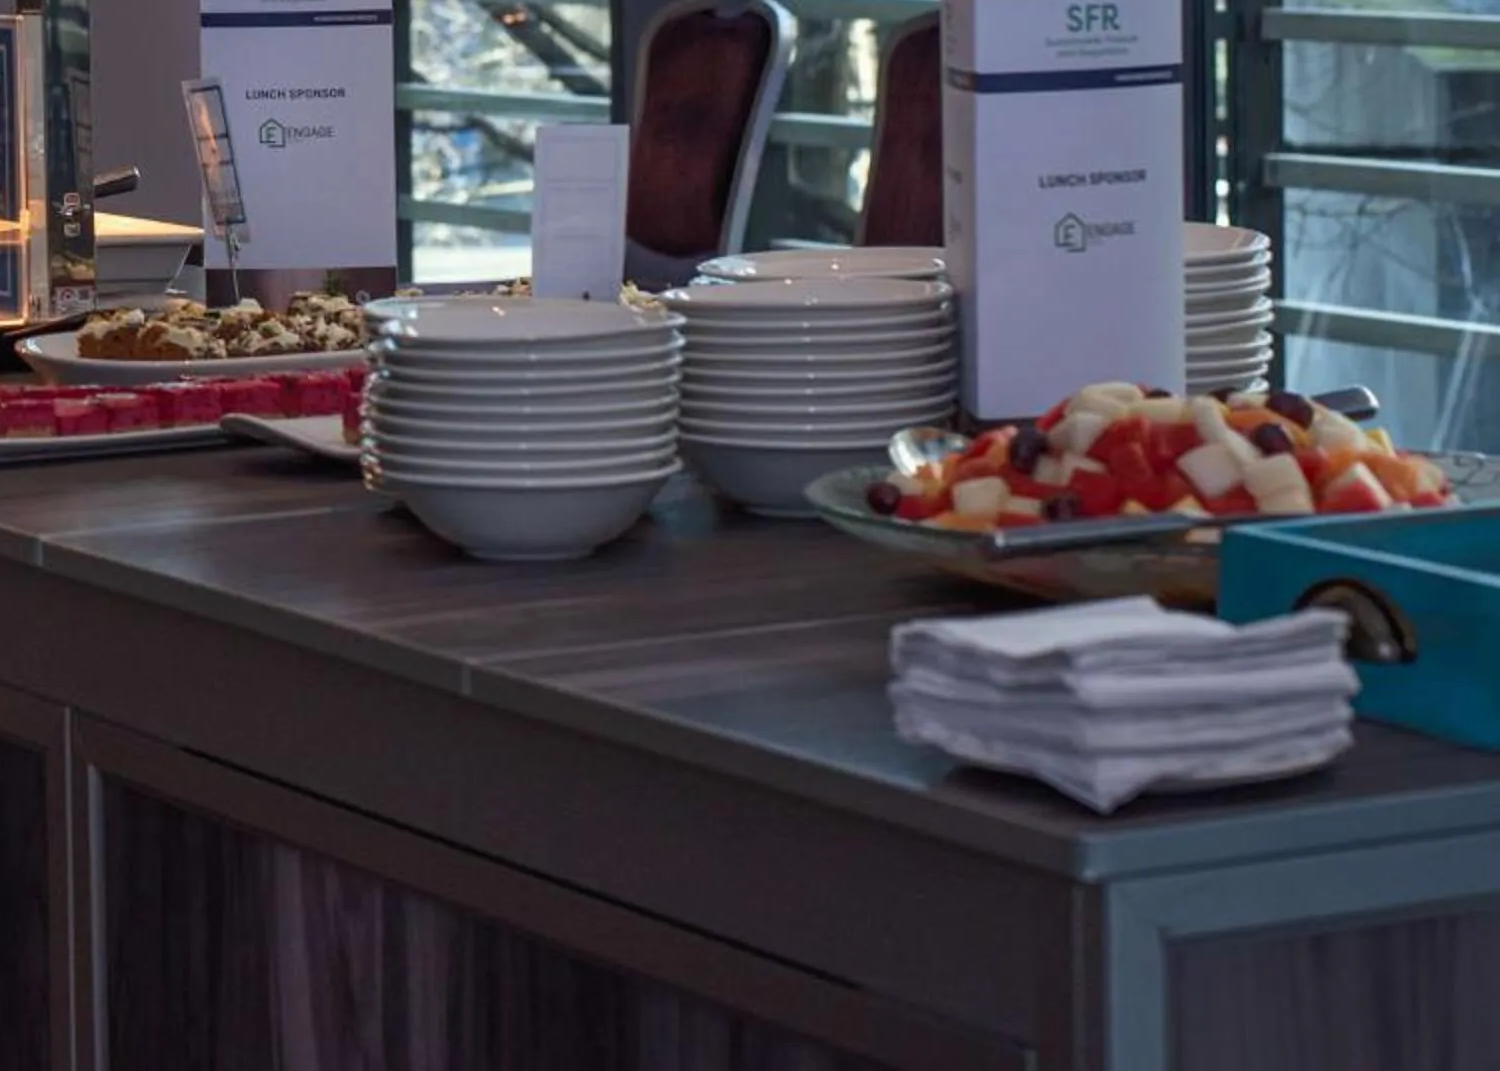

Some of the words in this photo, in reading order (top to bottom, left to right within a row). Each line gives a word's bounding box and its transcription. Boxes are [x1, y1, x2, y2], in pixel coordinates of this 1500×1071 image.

[1065, 3, 1122, 32] SFR
[245, 89, 286, 100] LUNCH
[289, 87, 346, 100] SPONSOR
[1038, 173, 1087, 189] LUNCH
[1089, 168, 1147, 186] SPONSOR
